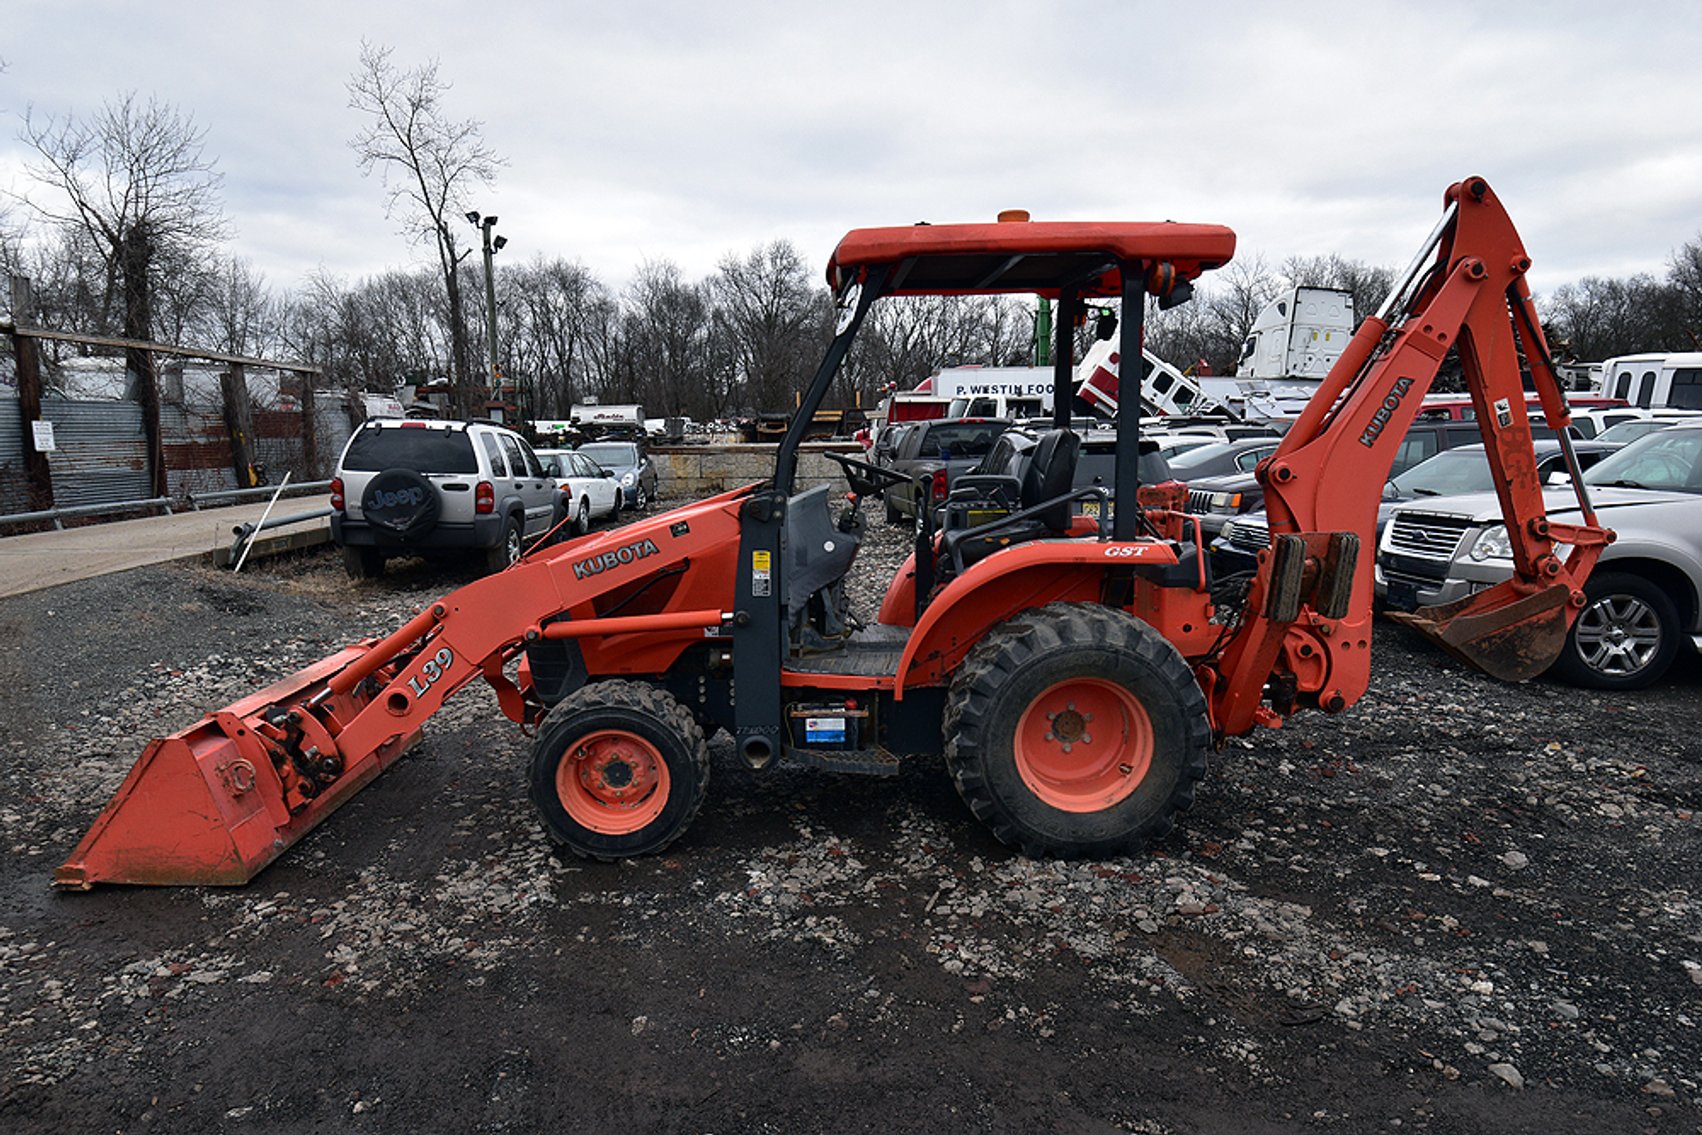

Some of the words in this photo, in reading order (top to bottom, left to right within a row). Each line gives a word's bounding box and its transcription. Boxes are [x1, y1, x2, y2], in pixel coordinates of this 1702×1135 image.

[956, 385, 967, 395] P.
[970, 384, 1022, 395] WESTIN
[1358, 376, 1415, 448] KUBOTA
[367, 487, 423, 509] Jeep
[572, 538, 659, 580] KUBOTA
[1104, 546, 1149, 557] GST
[407, 647, 453, 699] L39
